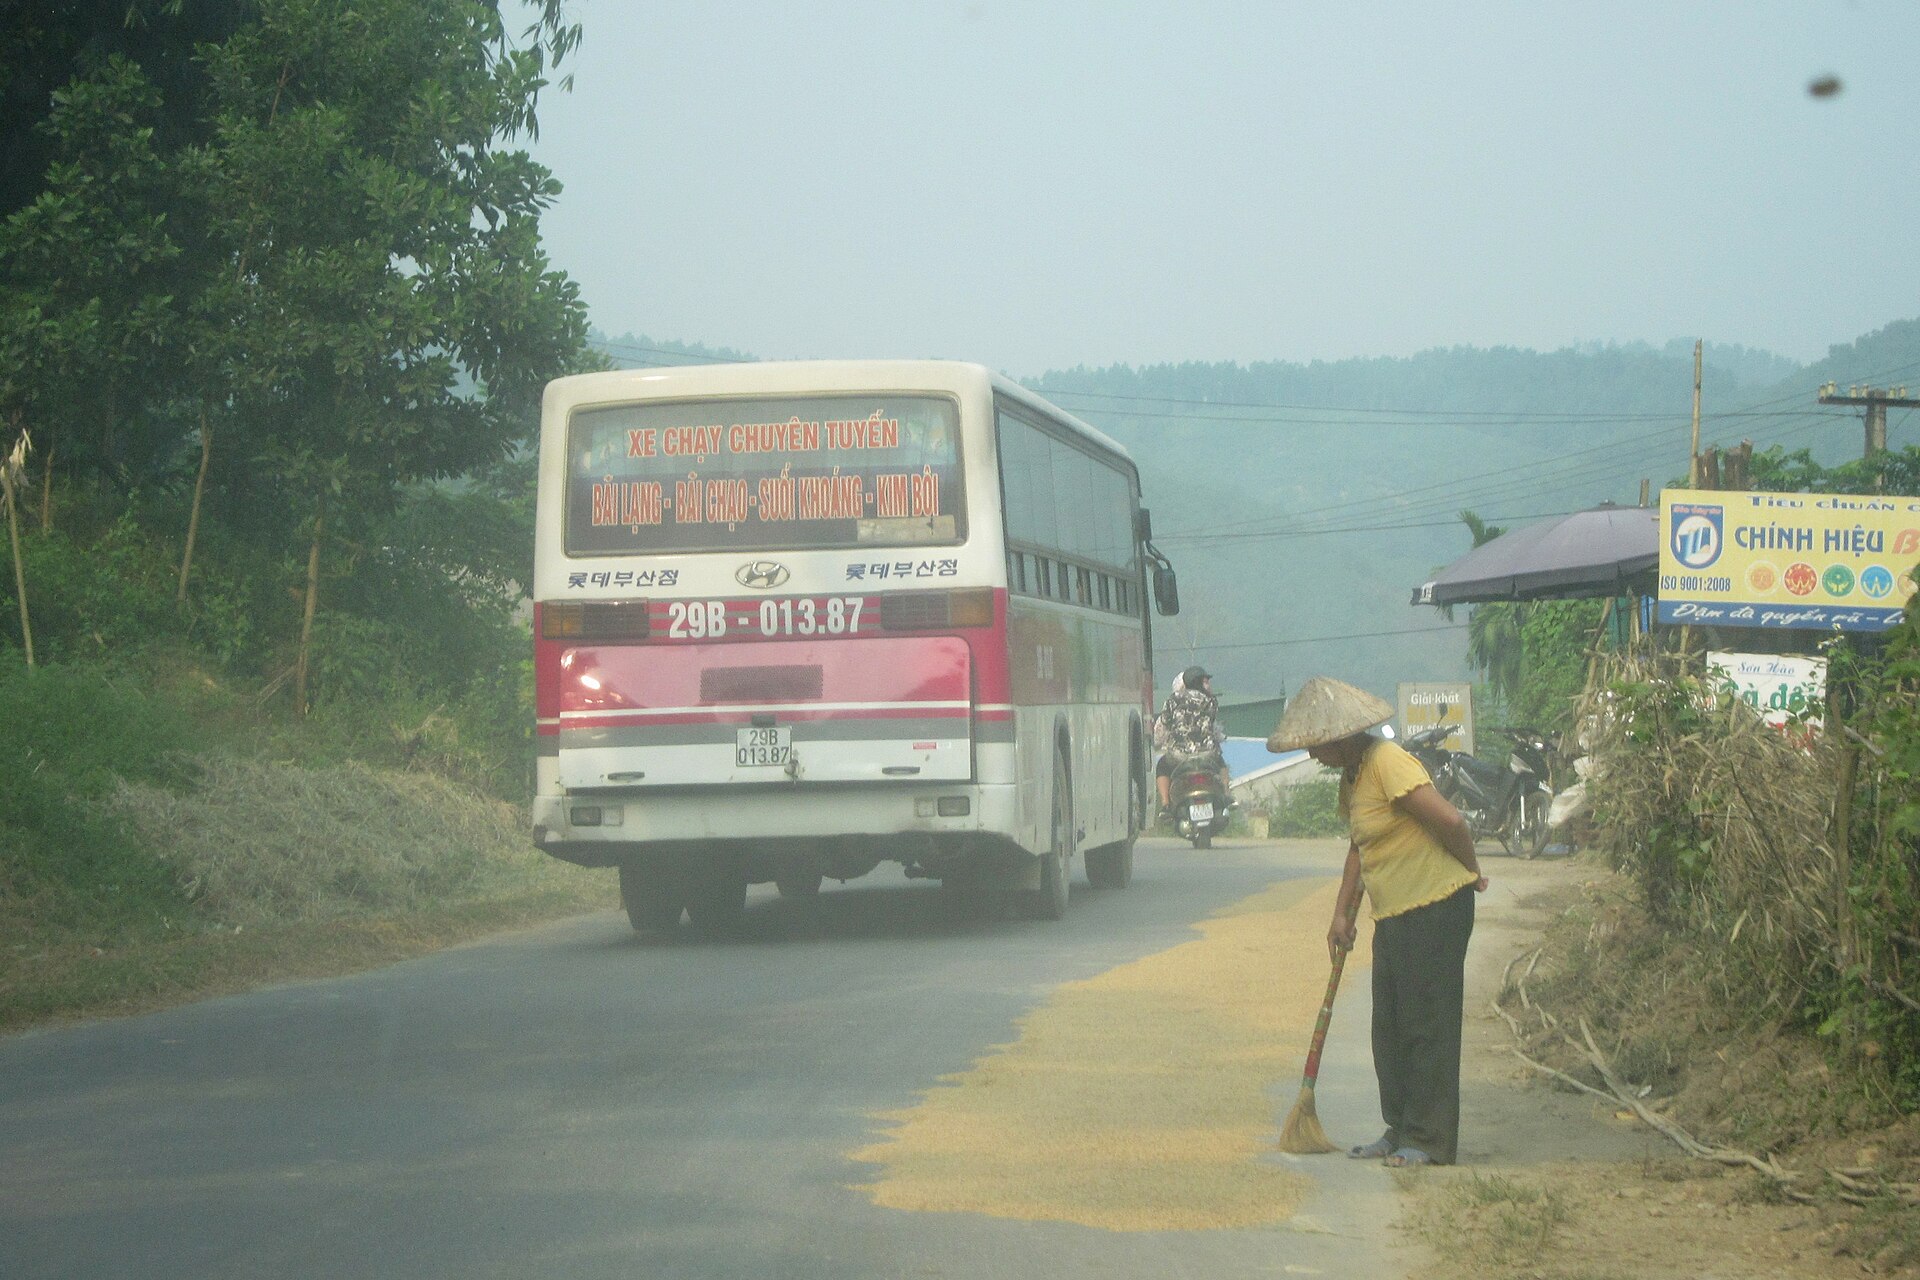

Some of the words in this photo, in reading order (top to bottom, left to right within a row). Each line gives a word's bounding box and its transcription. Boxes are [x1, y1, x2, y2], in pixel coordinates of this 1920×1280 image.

[628, 428, 657, 457] XE
[663, 424, 722, 463] CHẠY
[729, 416, 819, 453] CHUYÊN
[824, 409, 898, 449] TUYẾN
[621, 480, 662, 534] LẠNG
[705, 478, 748, 532] CHẠO
[758, 462, 796, 520] SUỐI
[799, 466, 863, 519] KHOÁNG
[876, 474, 908, 518] KIM
[911, 464, 939, 517] BÔI
[1734, 521, 1813, 552] CHÍNH
[1824, 524, 1884, 557] HIỆU
[1661, 576, 1677, 590] ISO
[1680, 576, 1731, 592] 9001:2008
[668, 601, 727, 639] 29B
[759, 597, 864, 635] 013.87
[1672, 603, 1724, 620] Đậm
[1729, 605, 1755, 619] đà
[1761, 608, 1827, 625] quyến
[750, 729, 778, 746] 29B
[738, 746, 790, 764] 013.87
